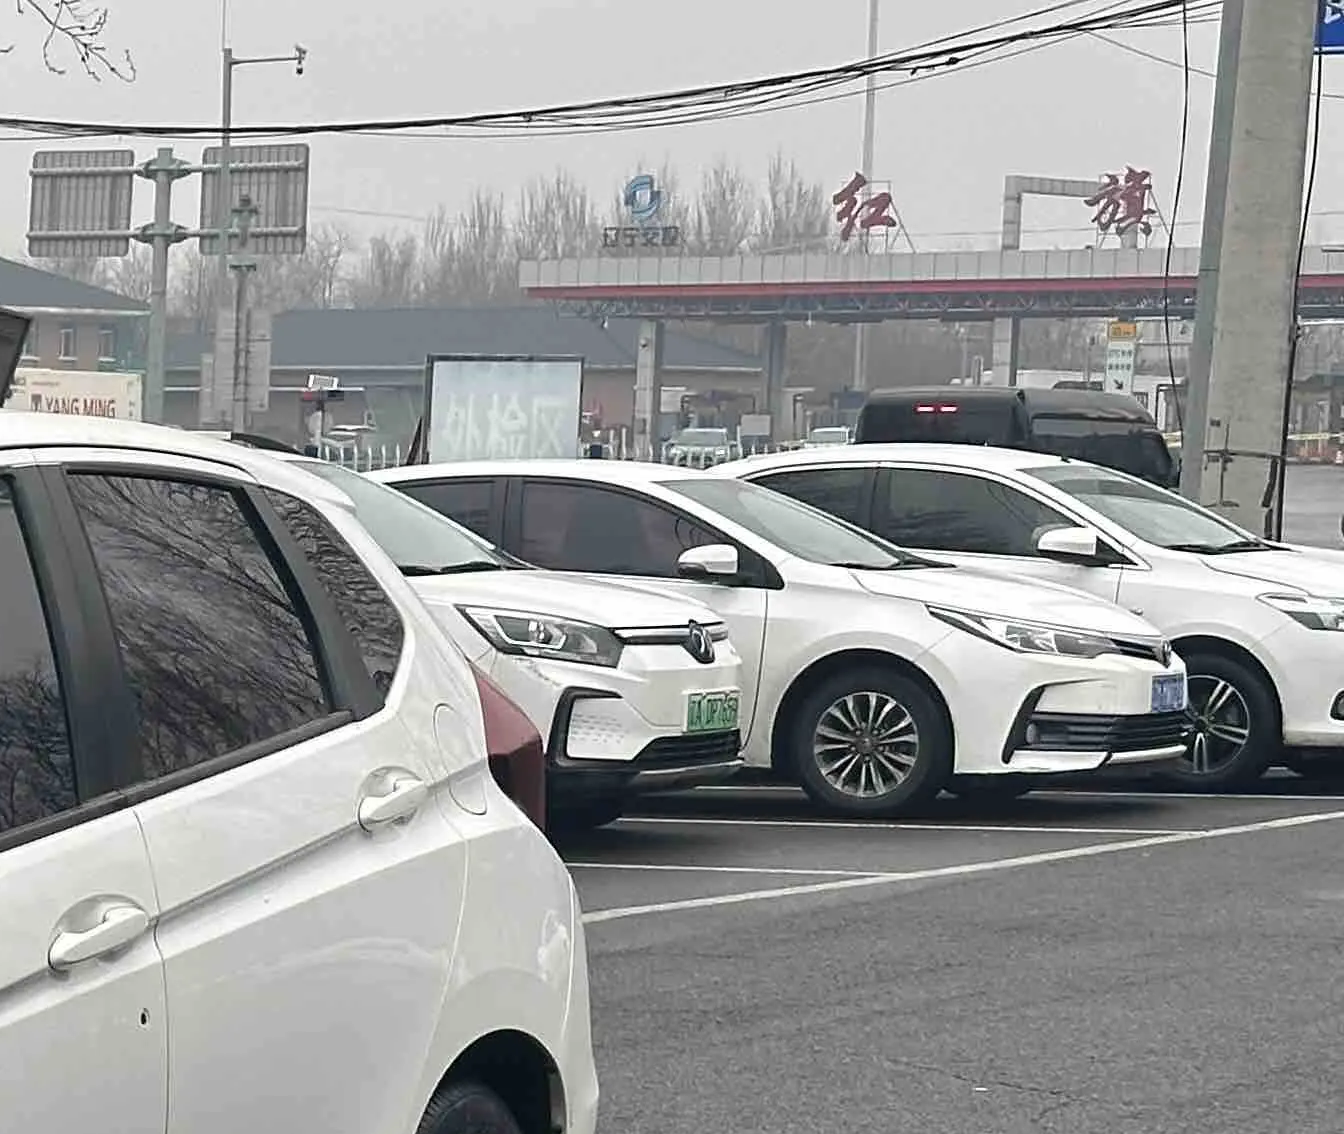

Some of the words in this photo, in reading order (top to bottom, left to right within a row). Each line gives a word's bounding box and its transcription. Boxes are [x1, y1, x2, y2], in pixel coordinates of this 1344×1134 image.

[831, 171, 897, 242] 红
[1083, 165, 1157, 237] 旗
[44, 397, 80, 416] YANG
[82, 398, 117, 419] MING
